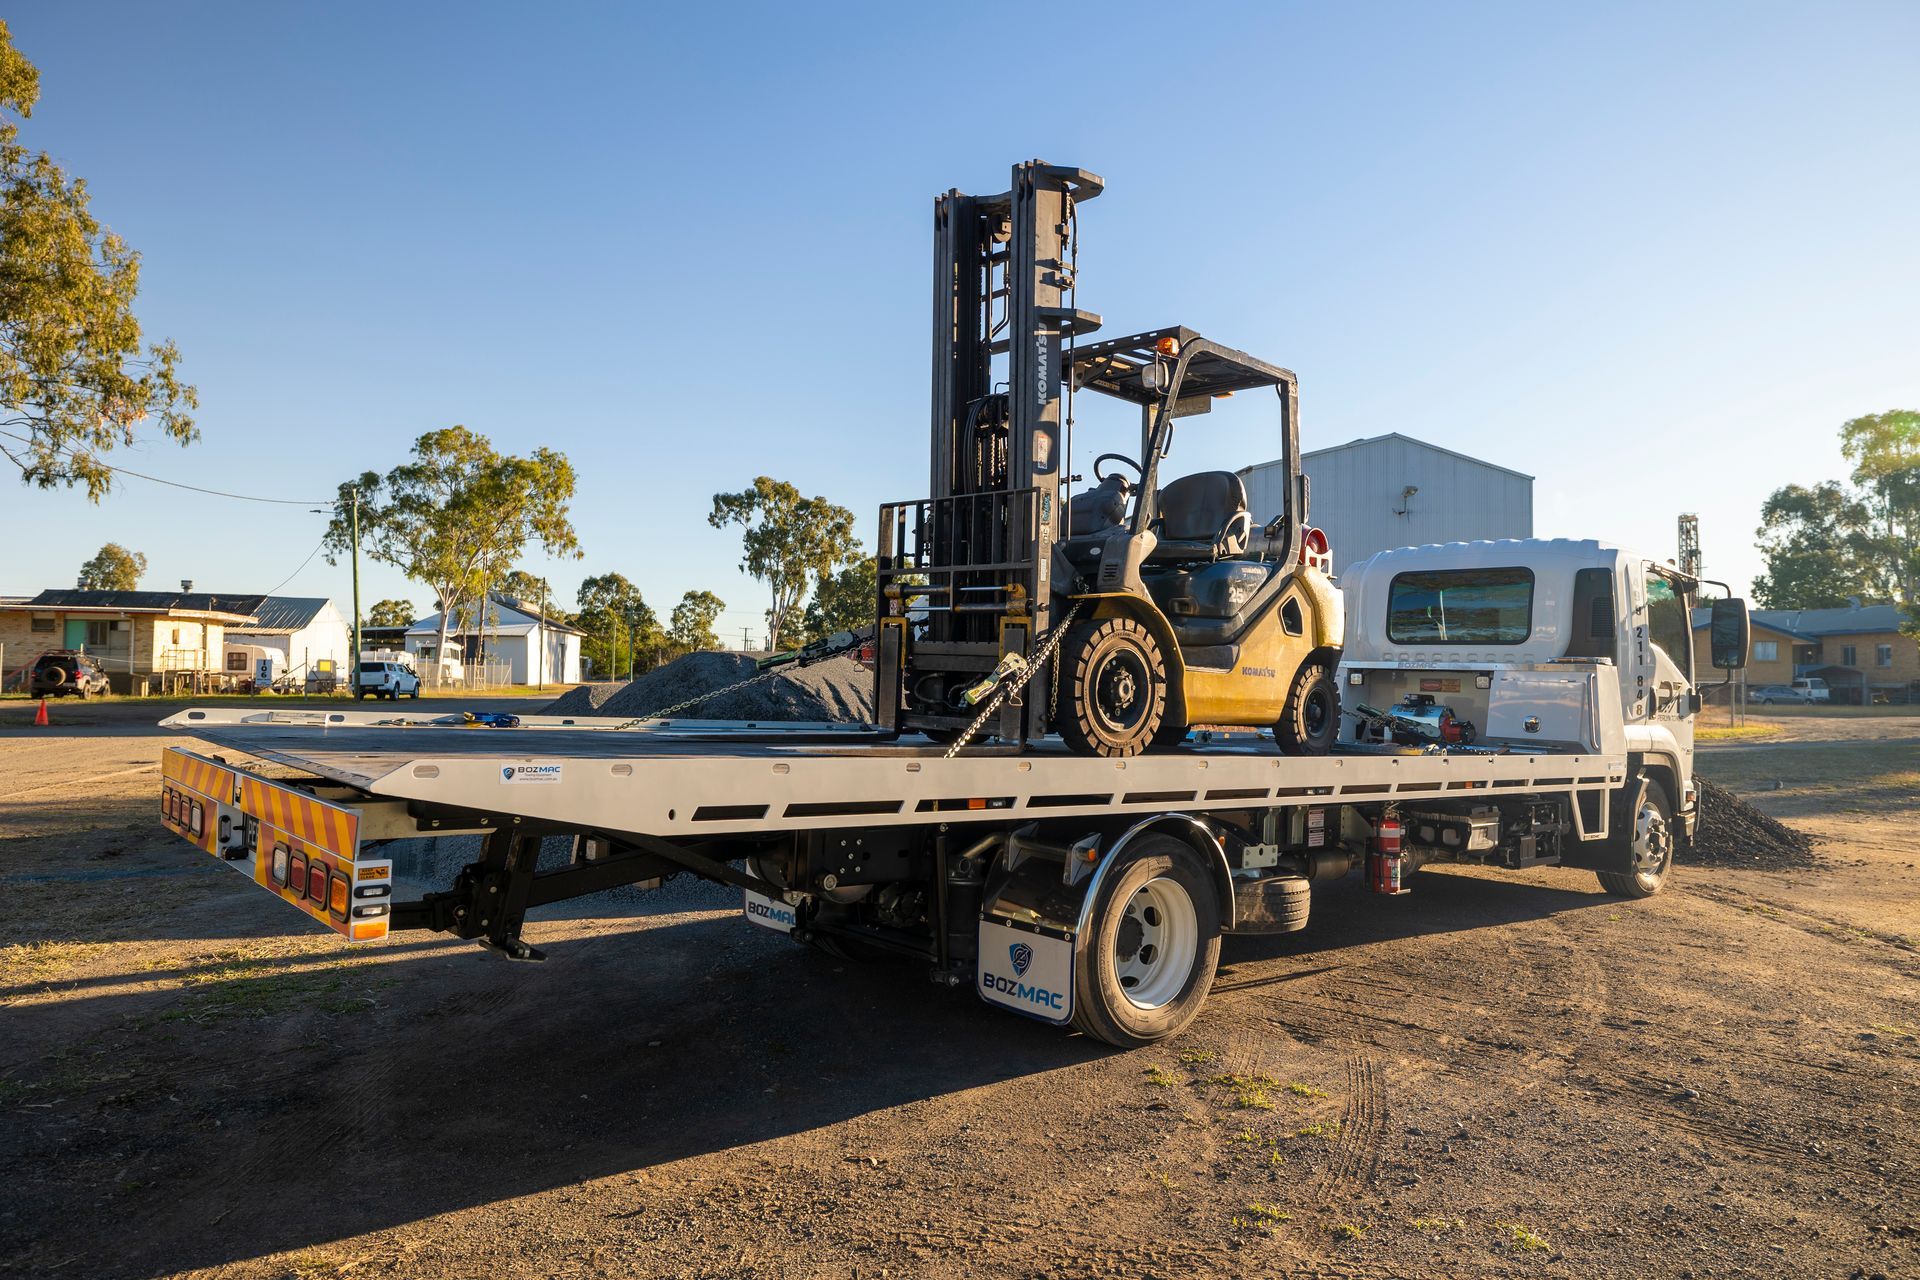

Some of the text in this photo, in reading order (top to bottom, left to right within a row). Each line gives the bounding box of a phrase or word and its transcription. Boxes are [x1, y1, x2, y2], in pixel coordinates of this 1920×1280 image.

[1037, 323, 1047, 404] KOMATSU
[1228, 587, 1244, 604] 25
[1242, 666, 1276, 678] KOMATSU
[1636, 675, 1644, 716] 848
[983, 972, 1063, 1010] BOZMAC
